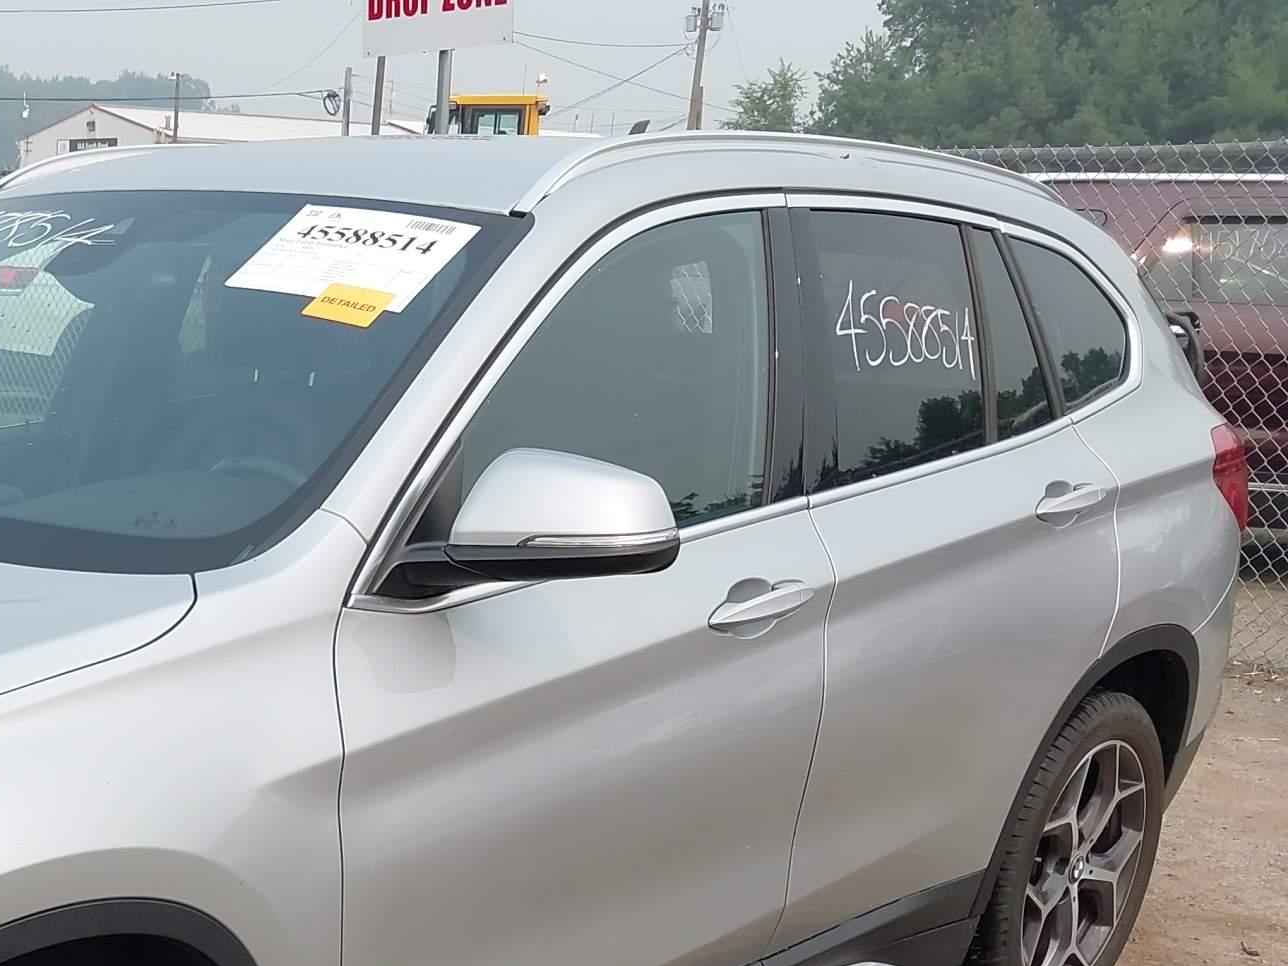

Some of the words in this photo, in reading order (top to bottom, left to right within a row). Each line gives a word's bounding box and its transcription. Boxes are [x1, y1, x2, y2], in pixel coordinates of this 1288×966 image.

[296, 223, 439, 255] 45588514
[320, 295, 377, 314] DETAILED
[835, 279, 976, 381] 45588514
